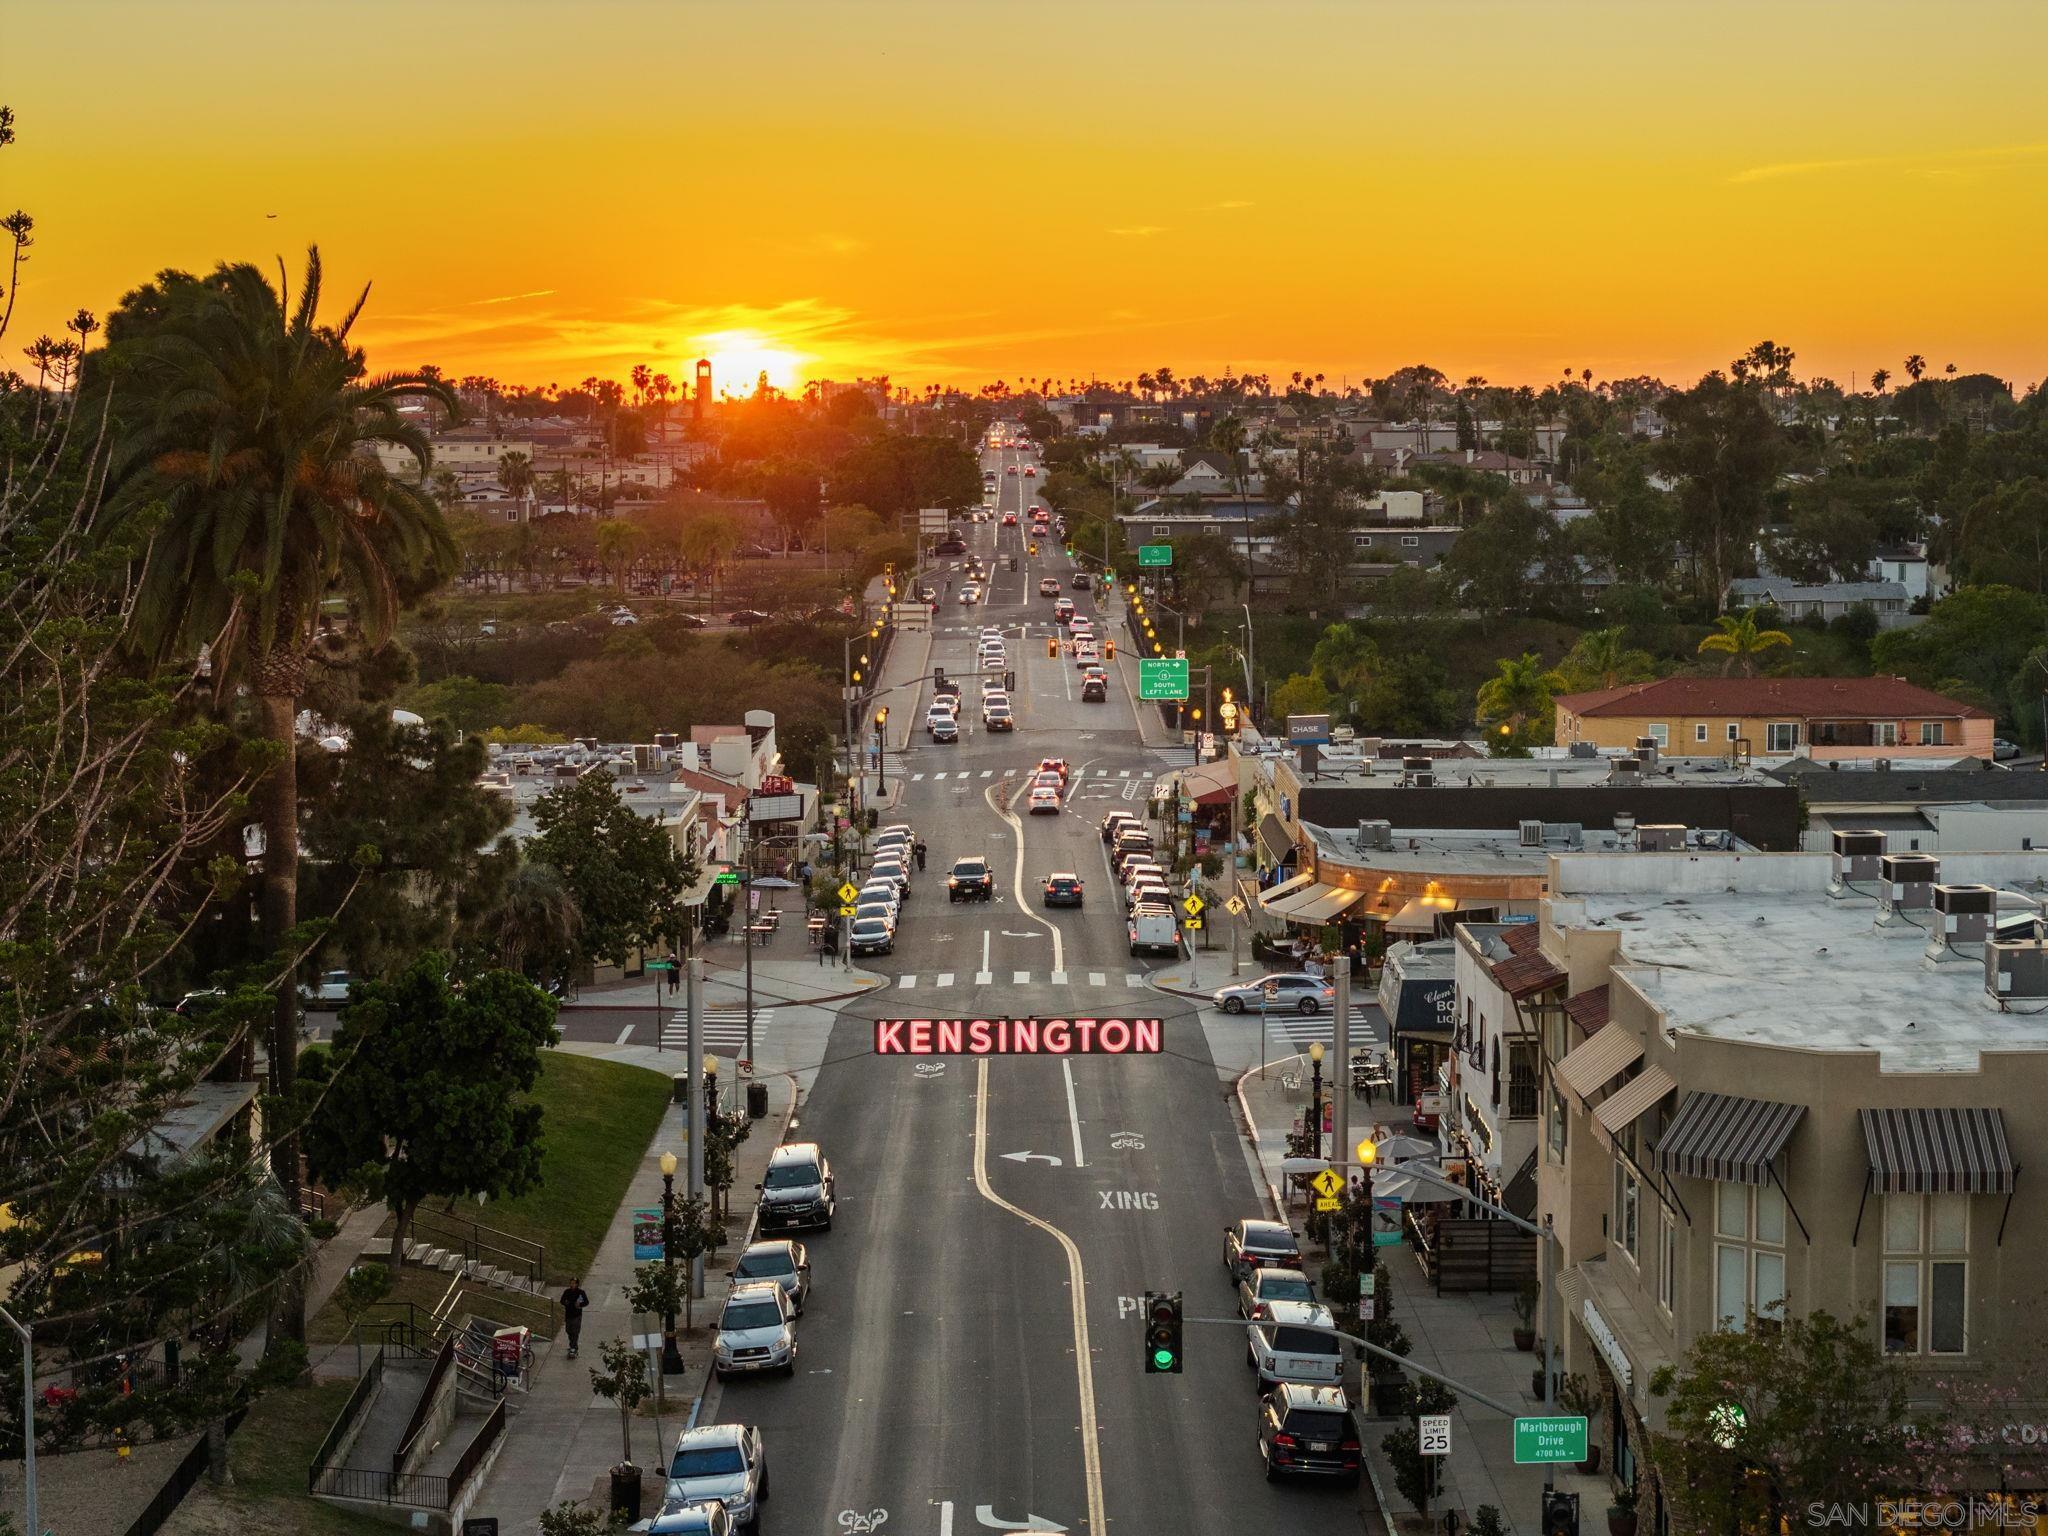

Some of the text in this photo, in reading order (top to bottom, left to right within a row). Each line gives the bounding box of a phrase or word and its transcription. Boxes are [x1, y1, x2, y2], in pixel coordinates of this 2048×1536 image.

[1291, 725, 1319, 733] CHASE
[878, 1019, 1160, 1053] KENSINGTON
[1098, 1190, 1160, 1210] XING
[1422, 1419, 1449, 1427] SPEED
[1520, 1421, 1582, 1434] Marlborough
[1425, 1427, 1446, 1435] LIMIT
[1423, 1435, 1448, 1450] 25
[1538, 1435, 1564, 1446] Drive
[1535, 1449, 1567, 1457] 4700 blk
